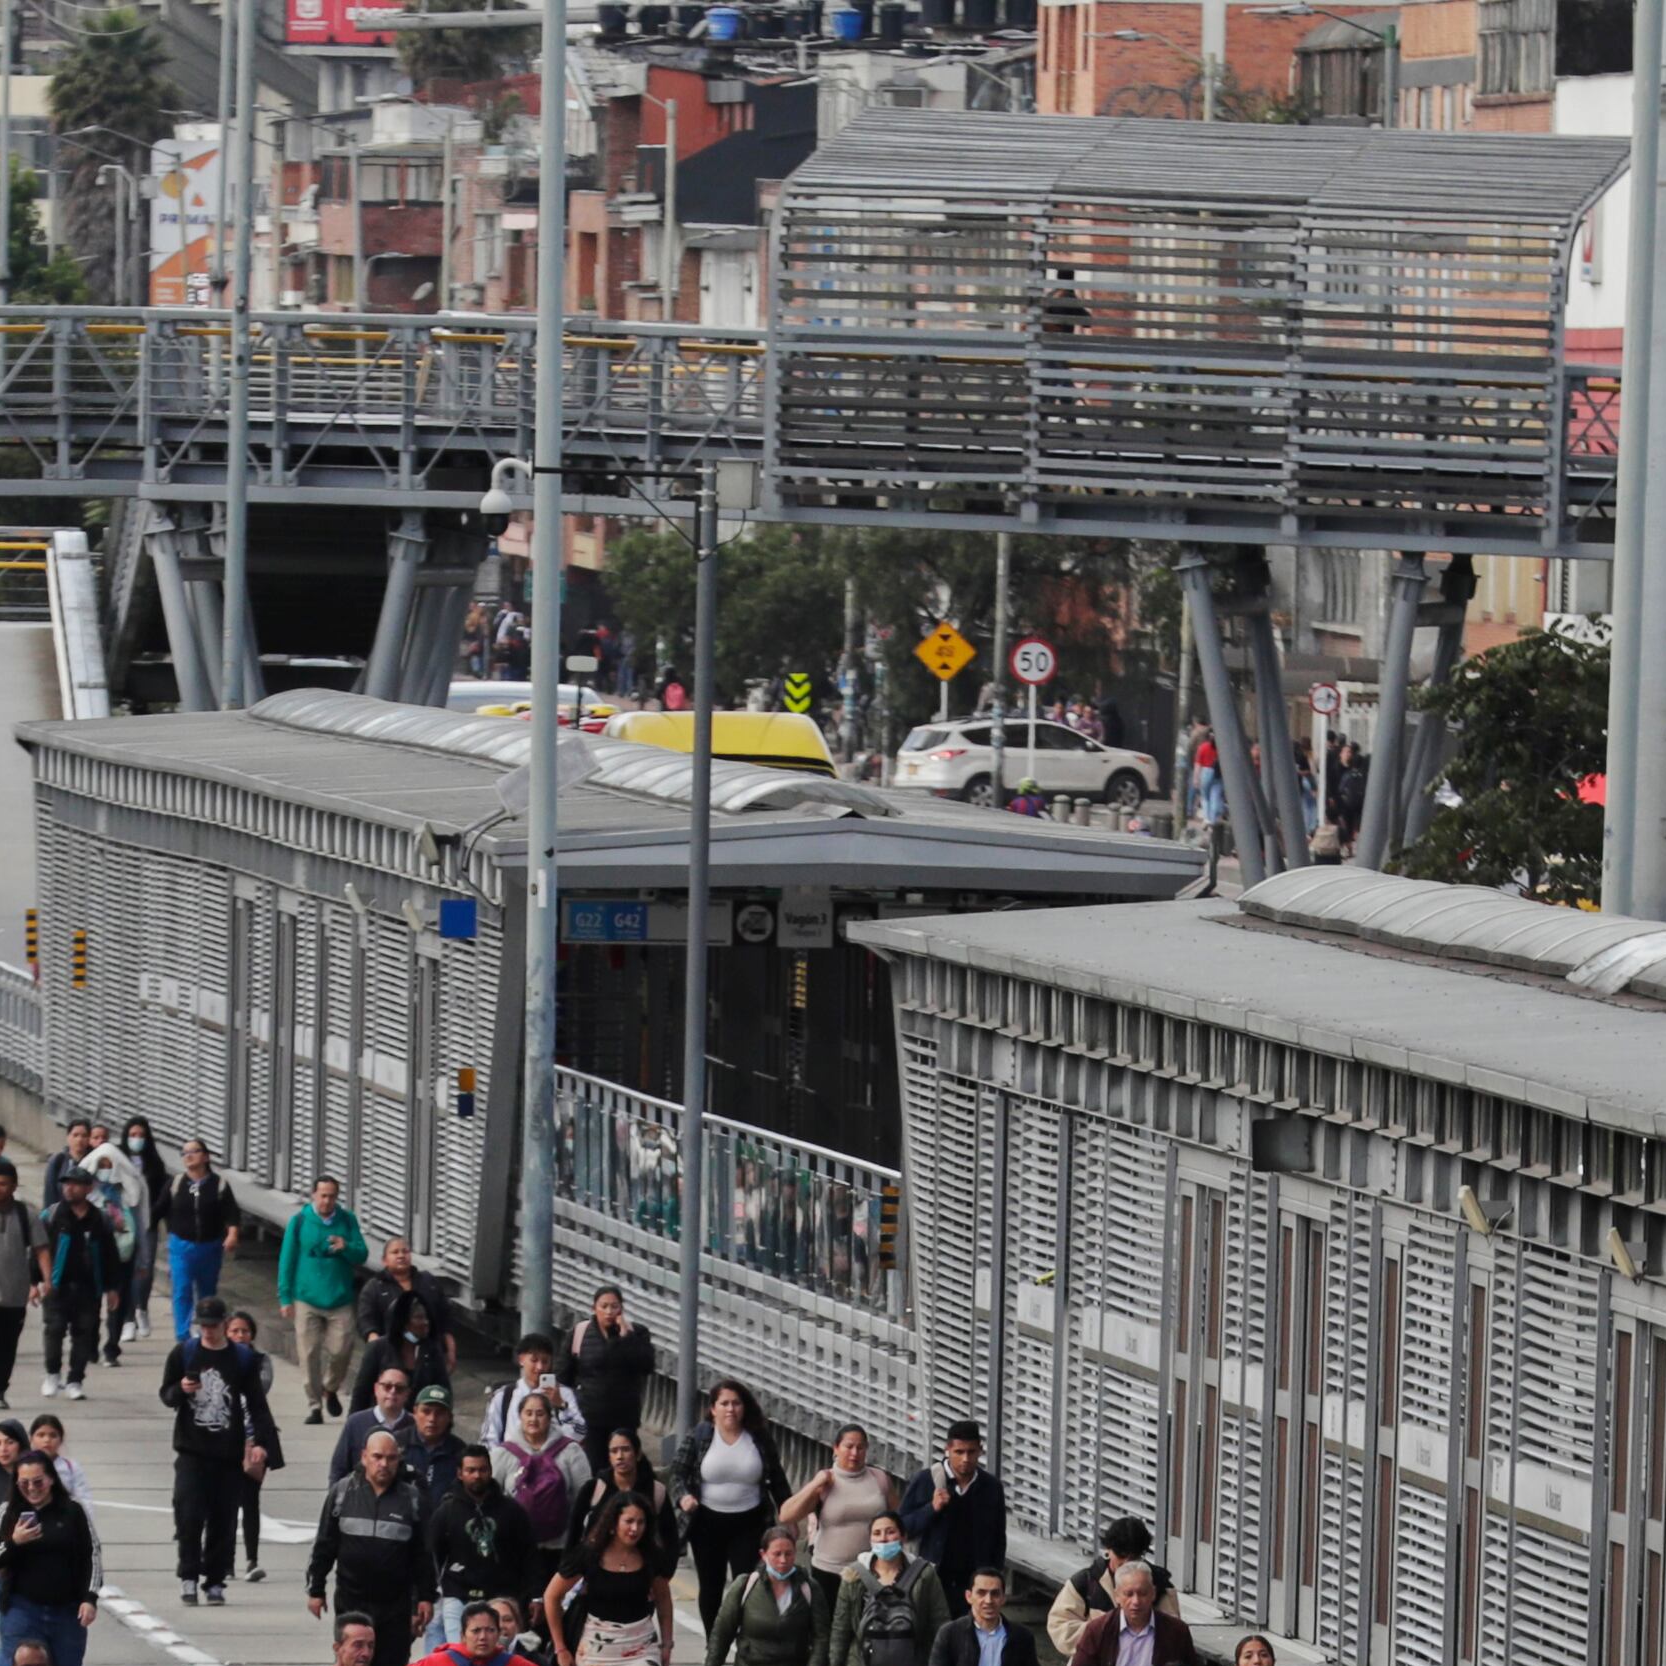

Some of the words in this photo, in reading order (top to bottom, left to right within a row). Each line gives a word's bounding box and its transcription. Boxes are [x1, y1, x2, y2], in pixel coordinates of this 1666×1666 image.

[1020, 651, 1049, 672] 50
[575, 913, 602, 926] G22
[614, 912, 641, 926] G42
